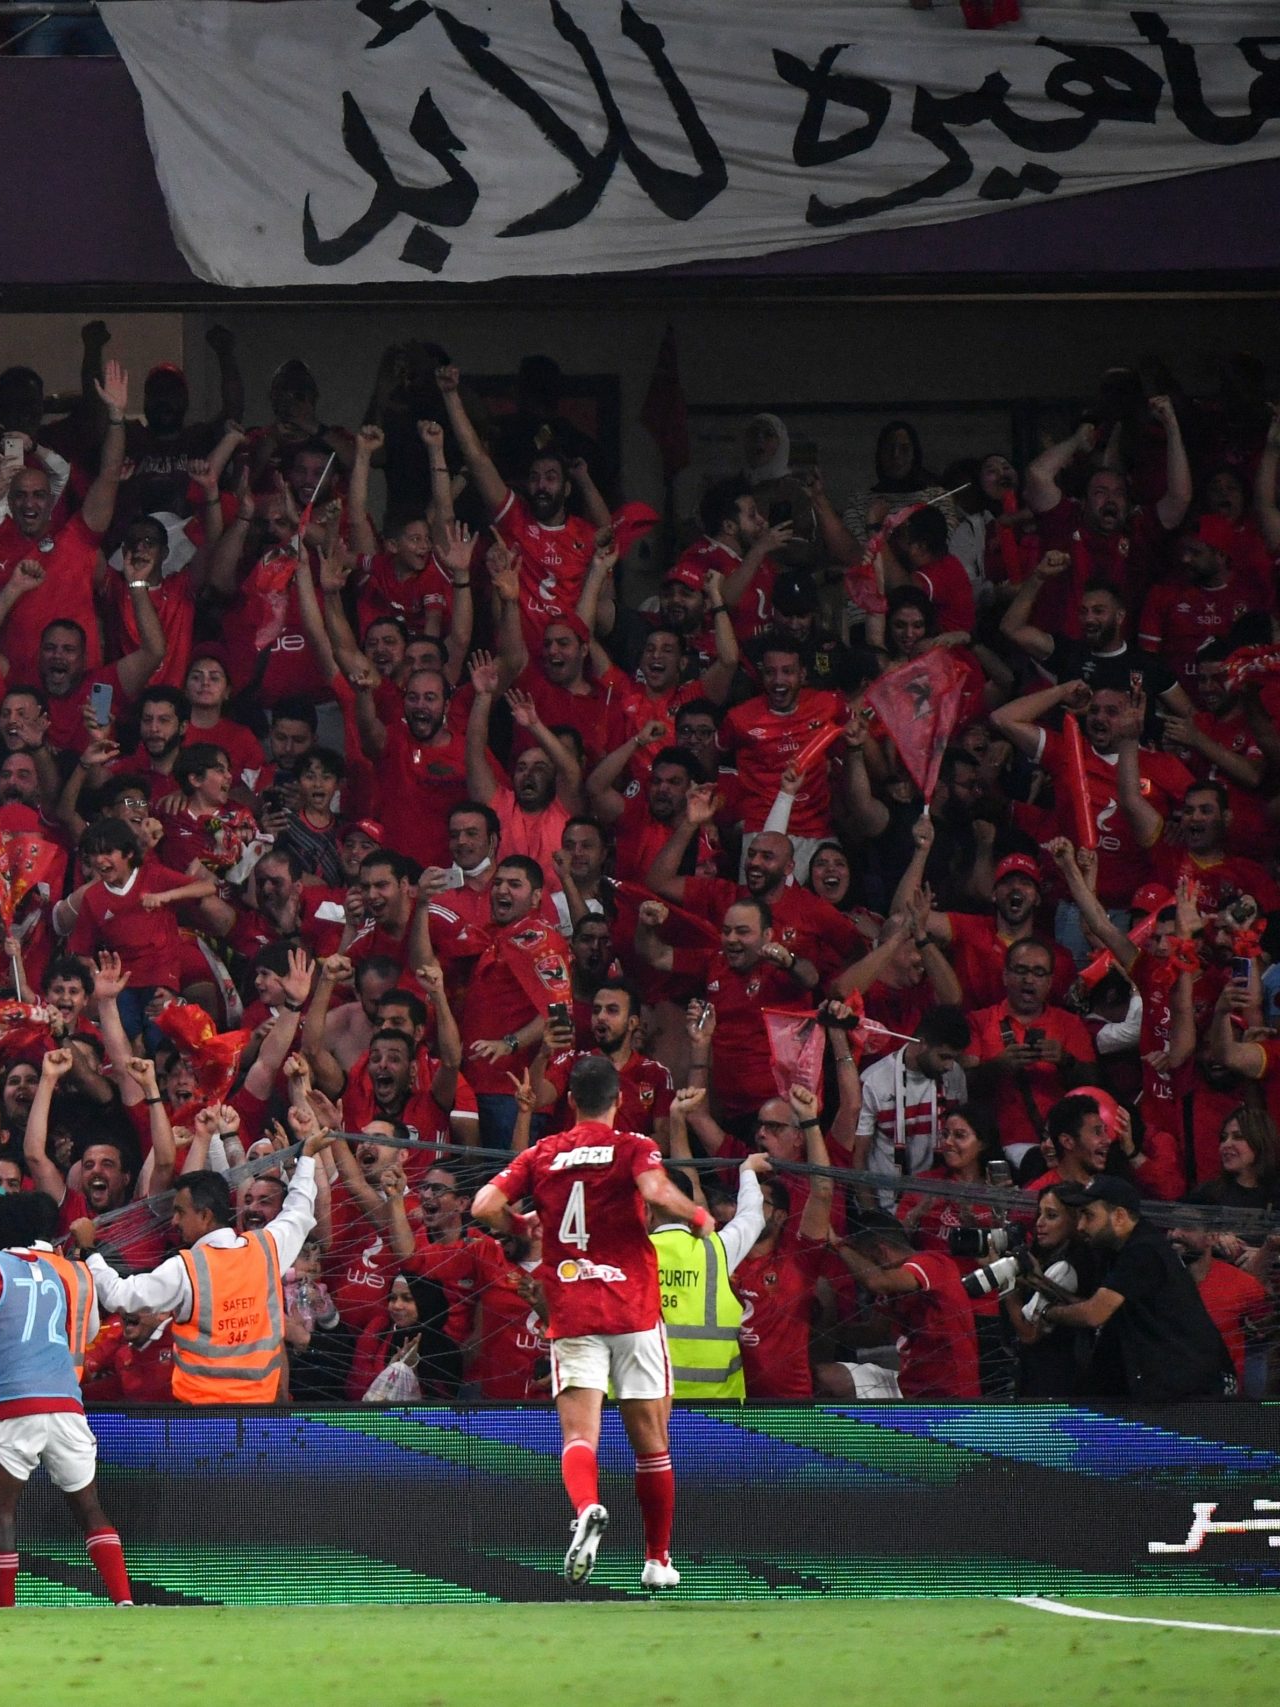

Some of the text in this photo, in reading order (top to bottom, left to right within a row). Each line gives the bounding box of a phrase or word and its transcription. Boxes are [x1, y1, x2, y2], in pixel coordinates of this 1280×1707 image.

[558, 1181, 591, 1251] 4
[13, 1278, 67, 1346] 72
[657, 1269, 700, 1287] CURITY
